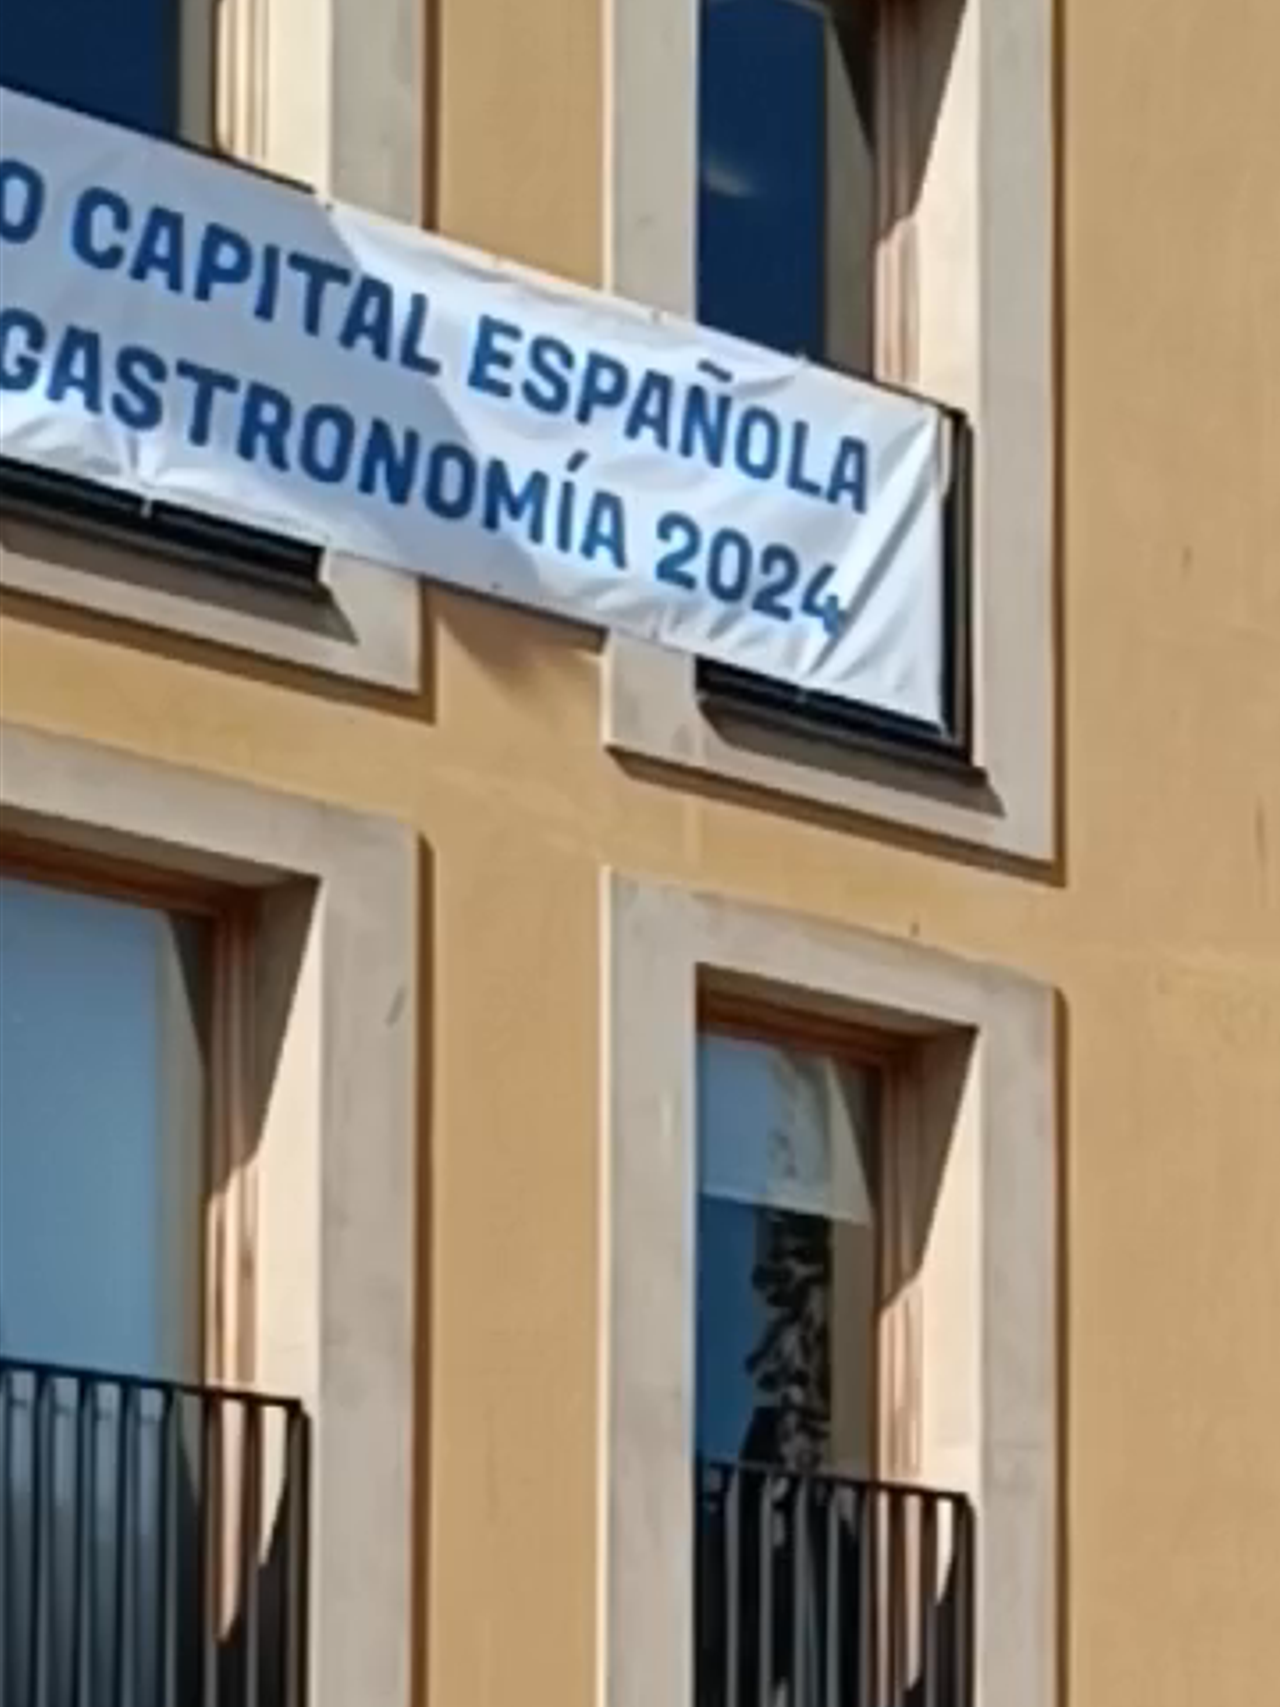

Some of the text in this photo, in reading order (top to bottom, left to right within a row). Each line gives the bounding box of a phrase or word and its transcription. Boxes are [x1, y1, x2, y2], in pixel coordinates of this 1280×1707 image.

[0, 307, 846, 640] GASTRONOMÍA 2024
[72, 186, 441, 376] CAPITAL
[467, 314, 868, 514] ESPAÑOLA
